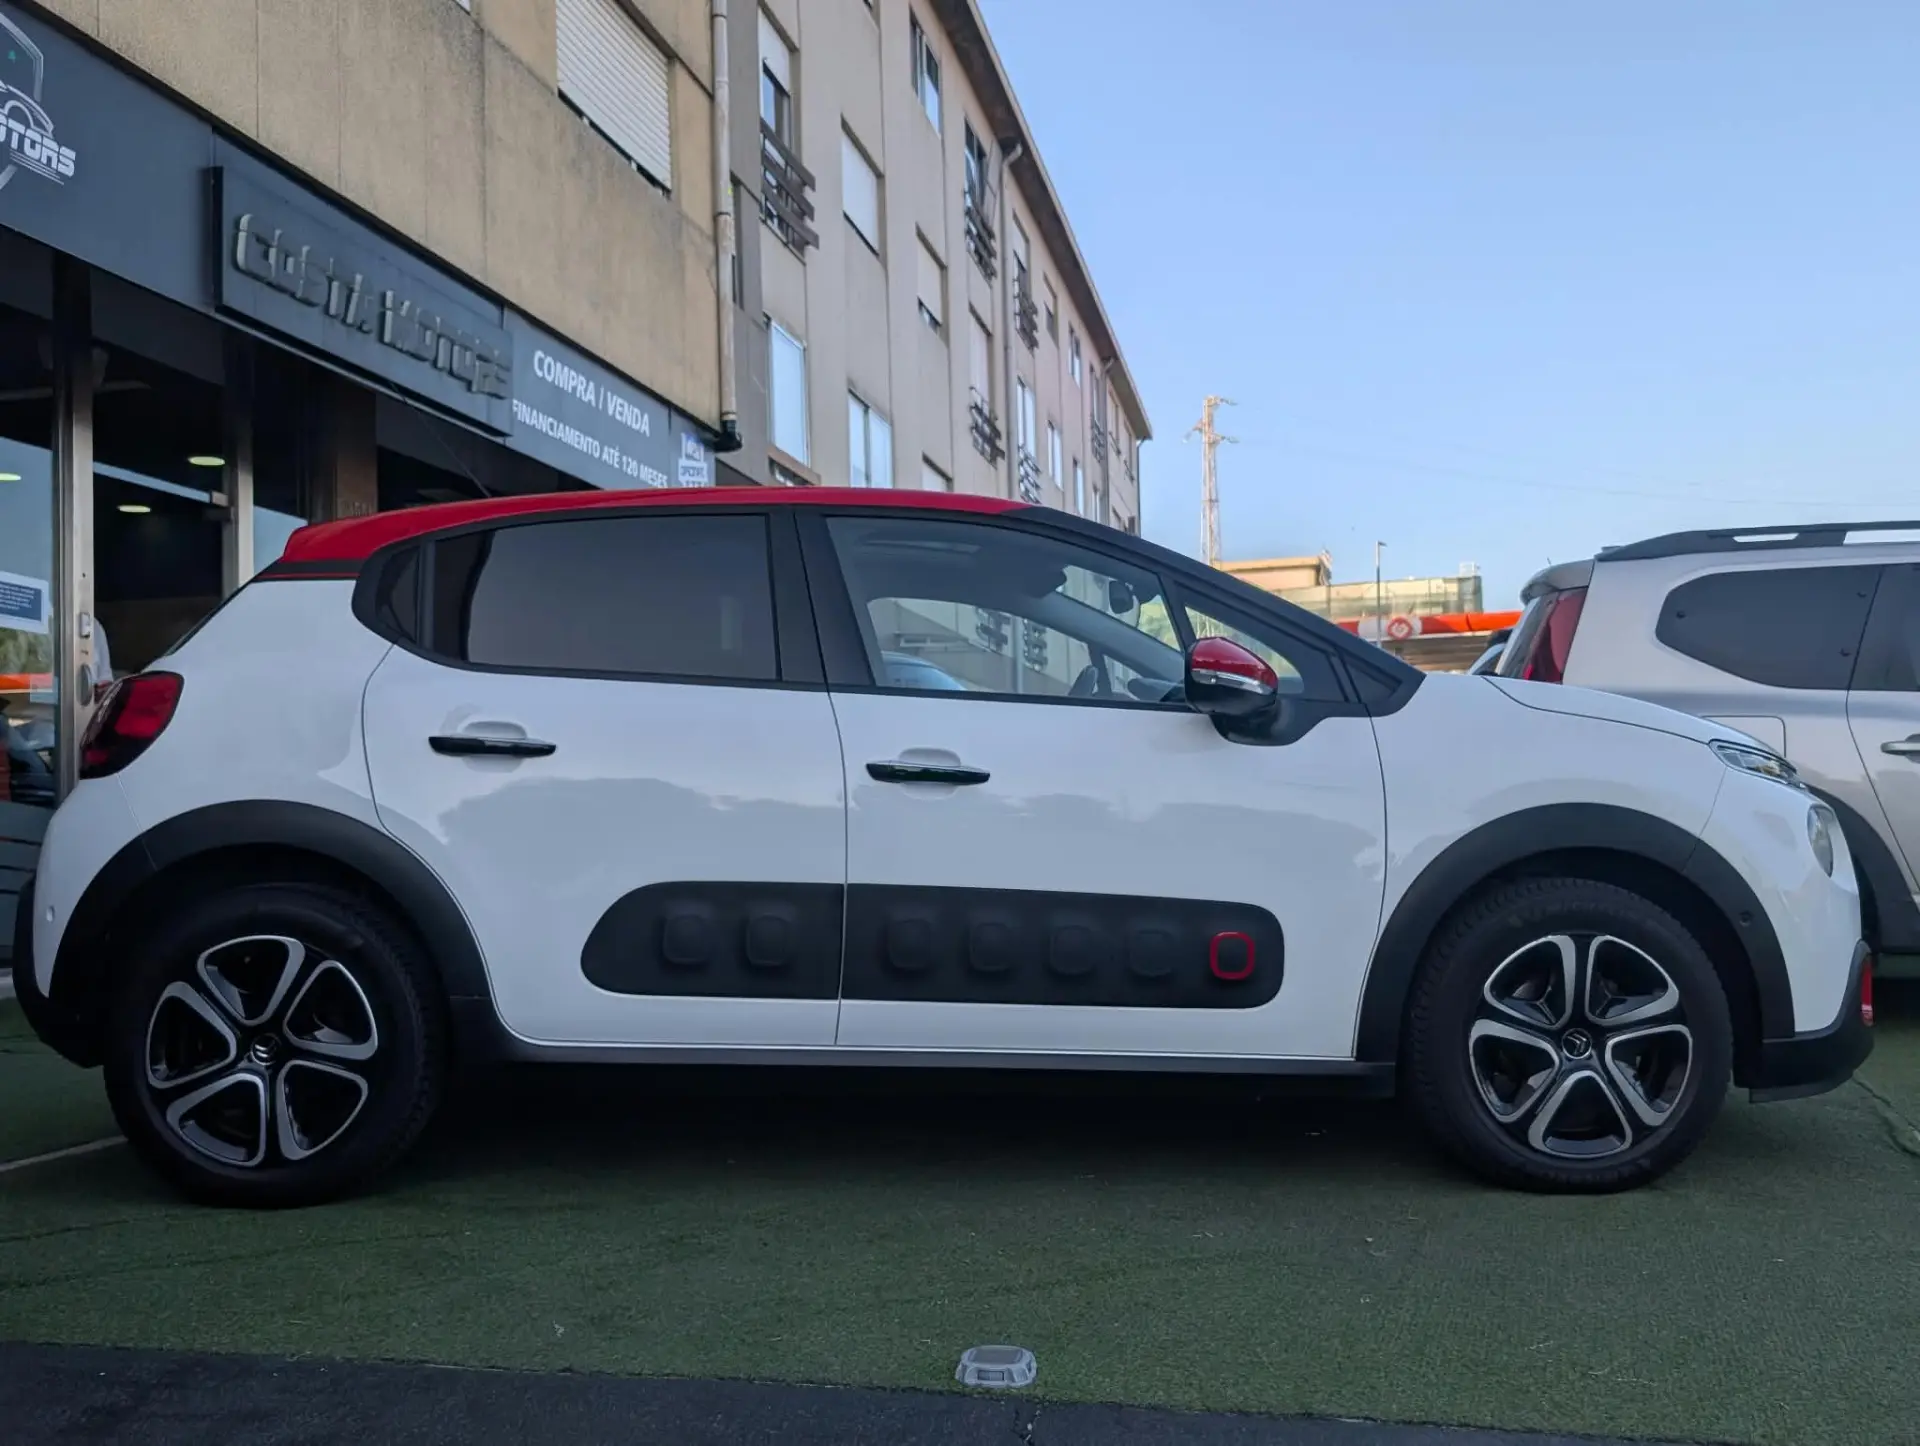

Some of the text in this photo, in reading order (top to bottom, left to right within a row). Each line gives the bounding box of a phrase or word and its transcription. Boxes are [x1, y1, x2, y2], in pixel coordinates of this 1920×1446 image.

[533, 350, 596, 409] COMPRA
[606, 390, 650, 438] VENDA
[512, 398, 601, 459] FINANCIAMENTO
[602, 445, 621, 469] ATÉ
[622, 455, 639, 478] 120
[640, 463, 669, 489] MESES
